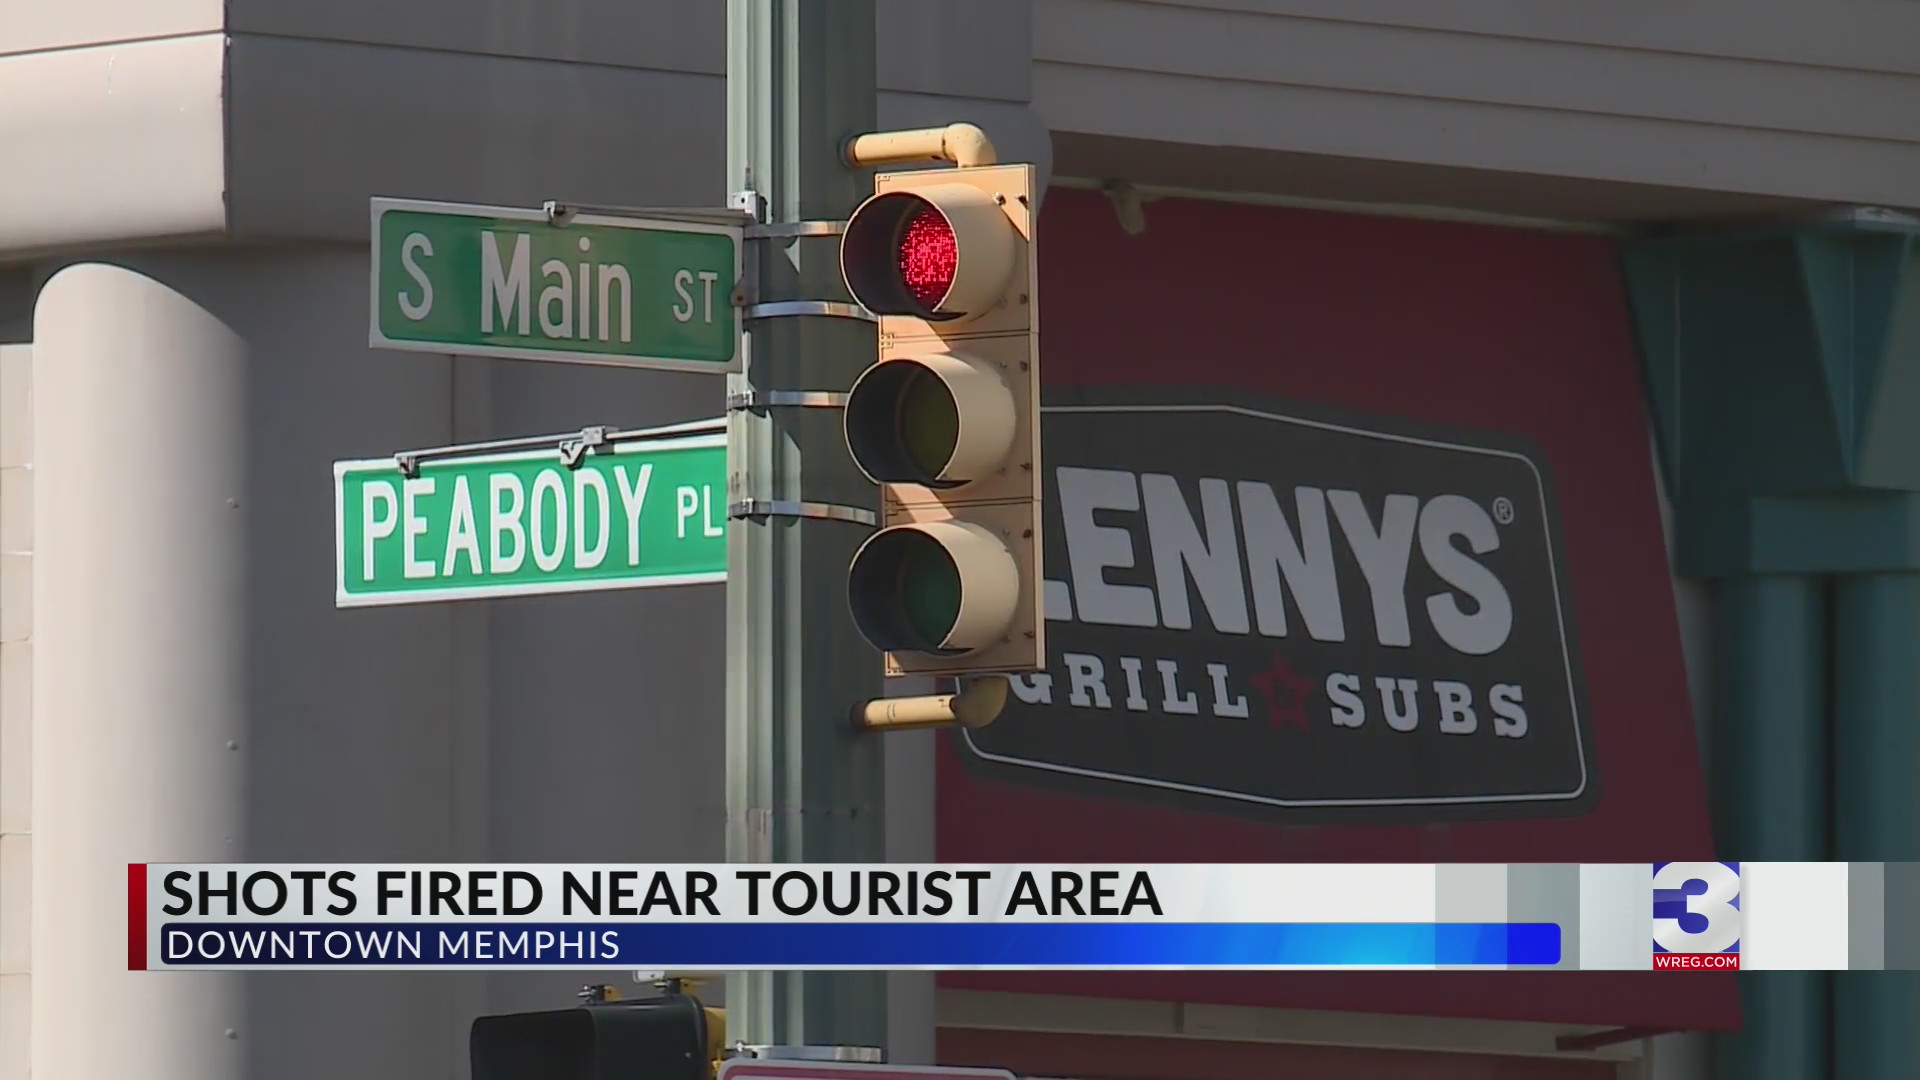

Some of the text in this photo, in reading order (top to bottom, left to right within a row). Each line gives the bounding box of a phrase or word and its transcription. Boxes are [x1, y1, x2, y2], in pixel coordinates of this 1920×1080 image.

[398, 230, 718, 342] S Main ST
[362, 463, 723, 581] PEABODY PL
[1325, 671, 1529, 738] SUBS
